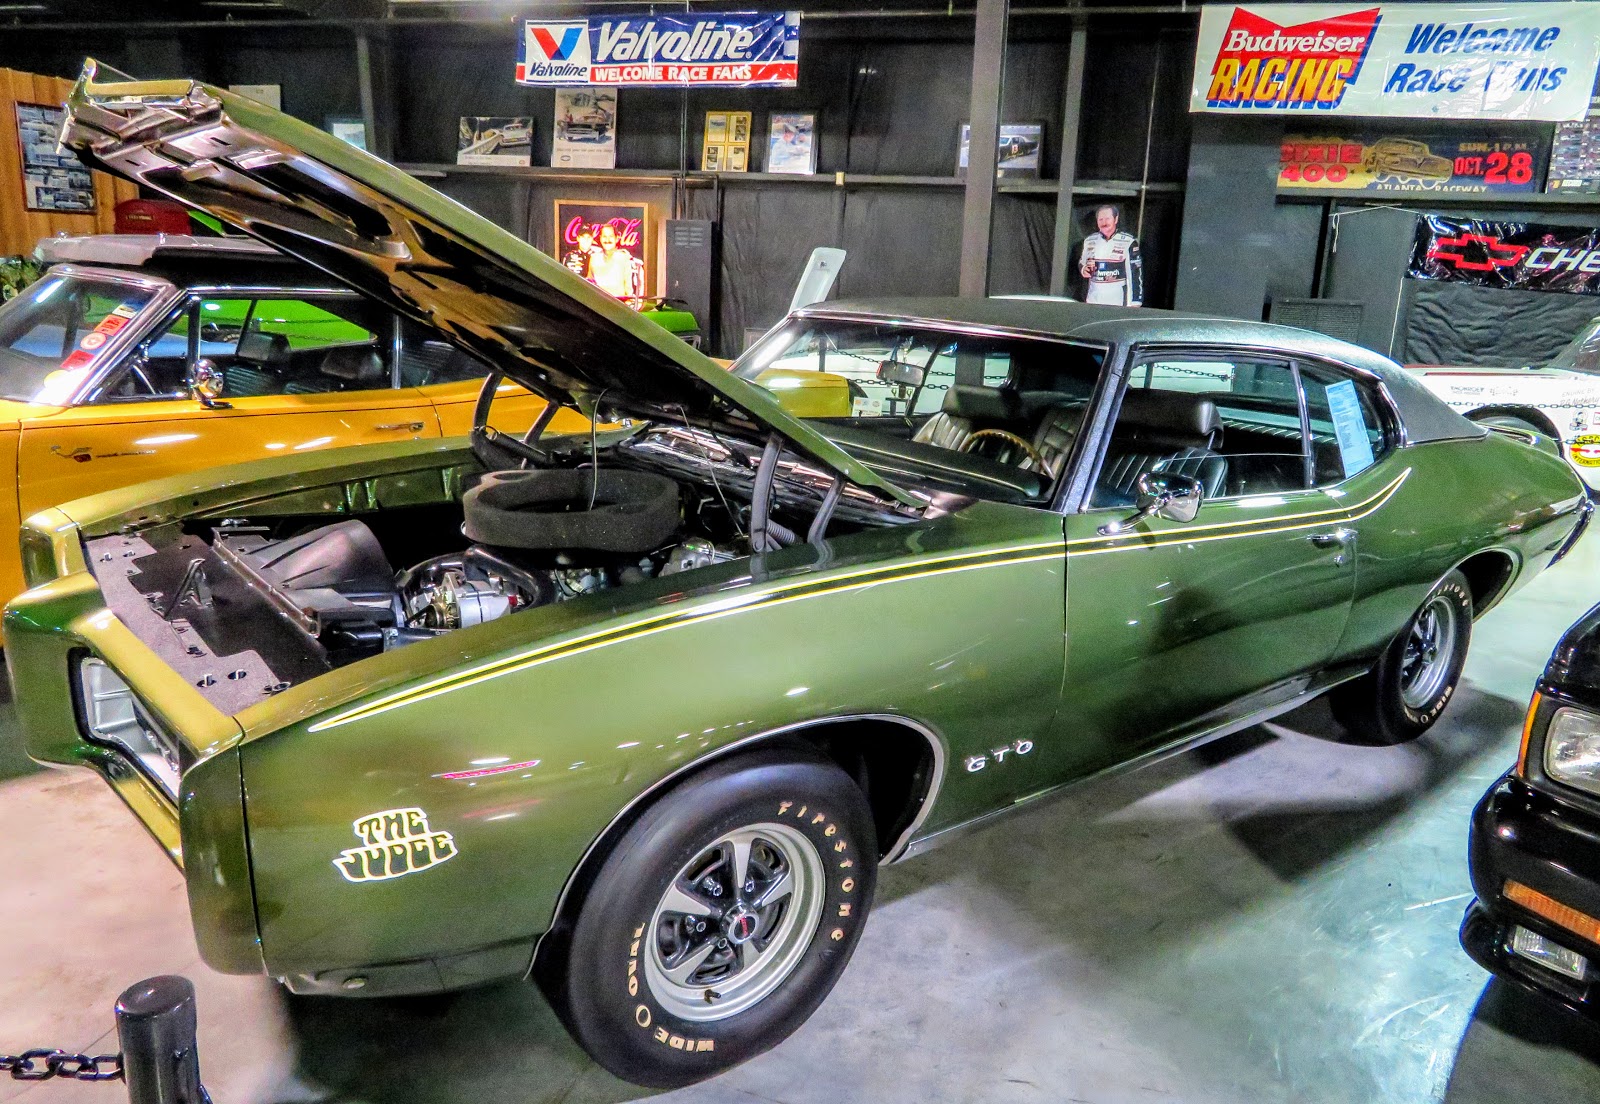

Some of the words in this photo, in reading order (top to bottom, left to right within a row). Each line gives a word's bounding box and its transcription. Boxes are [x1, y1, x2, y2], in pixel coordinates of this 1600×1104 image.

[595, 20, 754, 62] Valvoline
[1223, 29, 1366, 54] Budweiser
[1404, 22, 1561, 55] Welcome
[529, 61, 588, 78] Valvoline
[595, 66, 664, 82] WELCOME
[668, 65, 707, 81] RACE
[712, 65, 752, 81] FANS
[1205, 57, 1355, 101] RACING
[1384, 62, 1472, 94] Race
[1281, 163, 1348, 183] 400
[1454, 157, 1484, 176] OCT.
[1484, 151, 1534, 185] 28
[965, 739, 1034, 773] GTO
[353, 808, 430, 848] THE
[332, 832, 459, 882] JUDGE
[775, 801, 856, 943] Firestone
[654, 1026, 715, 1053] WIDE
